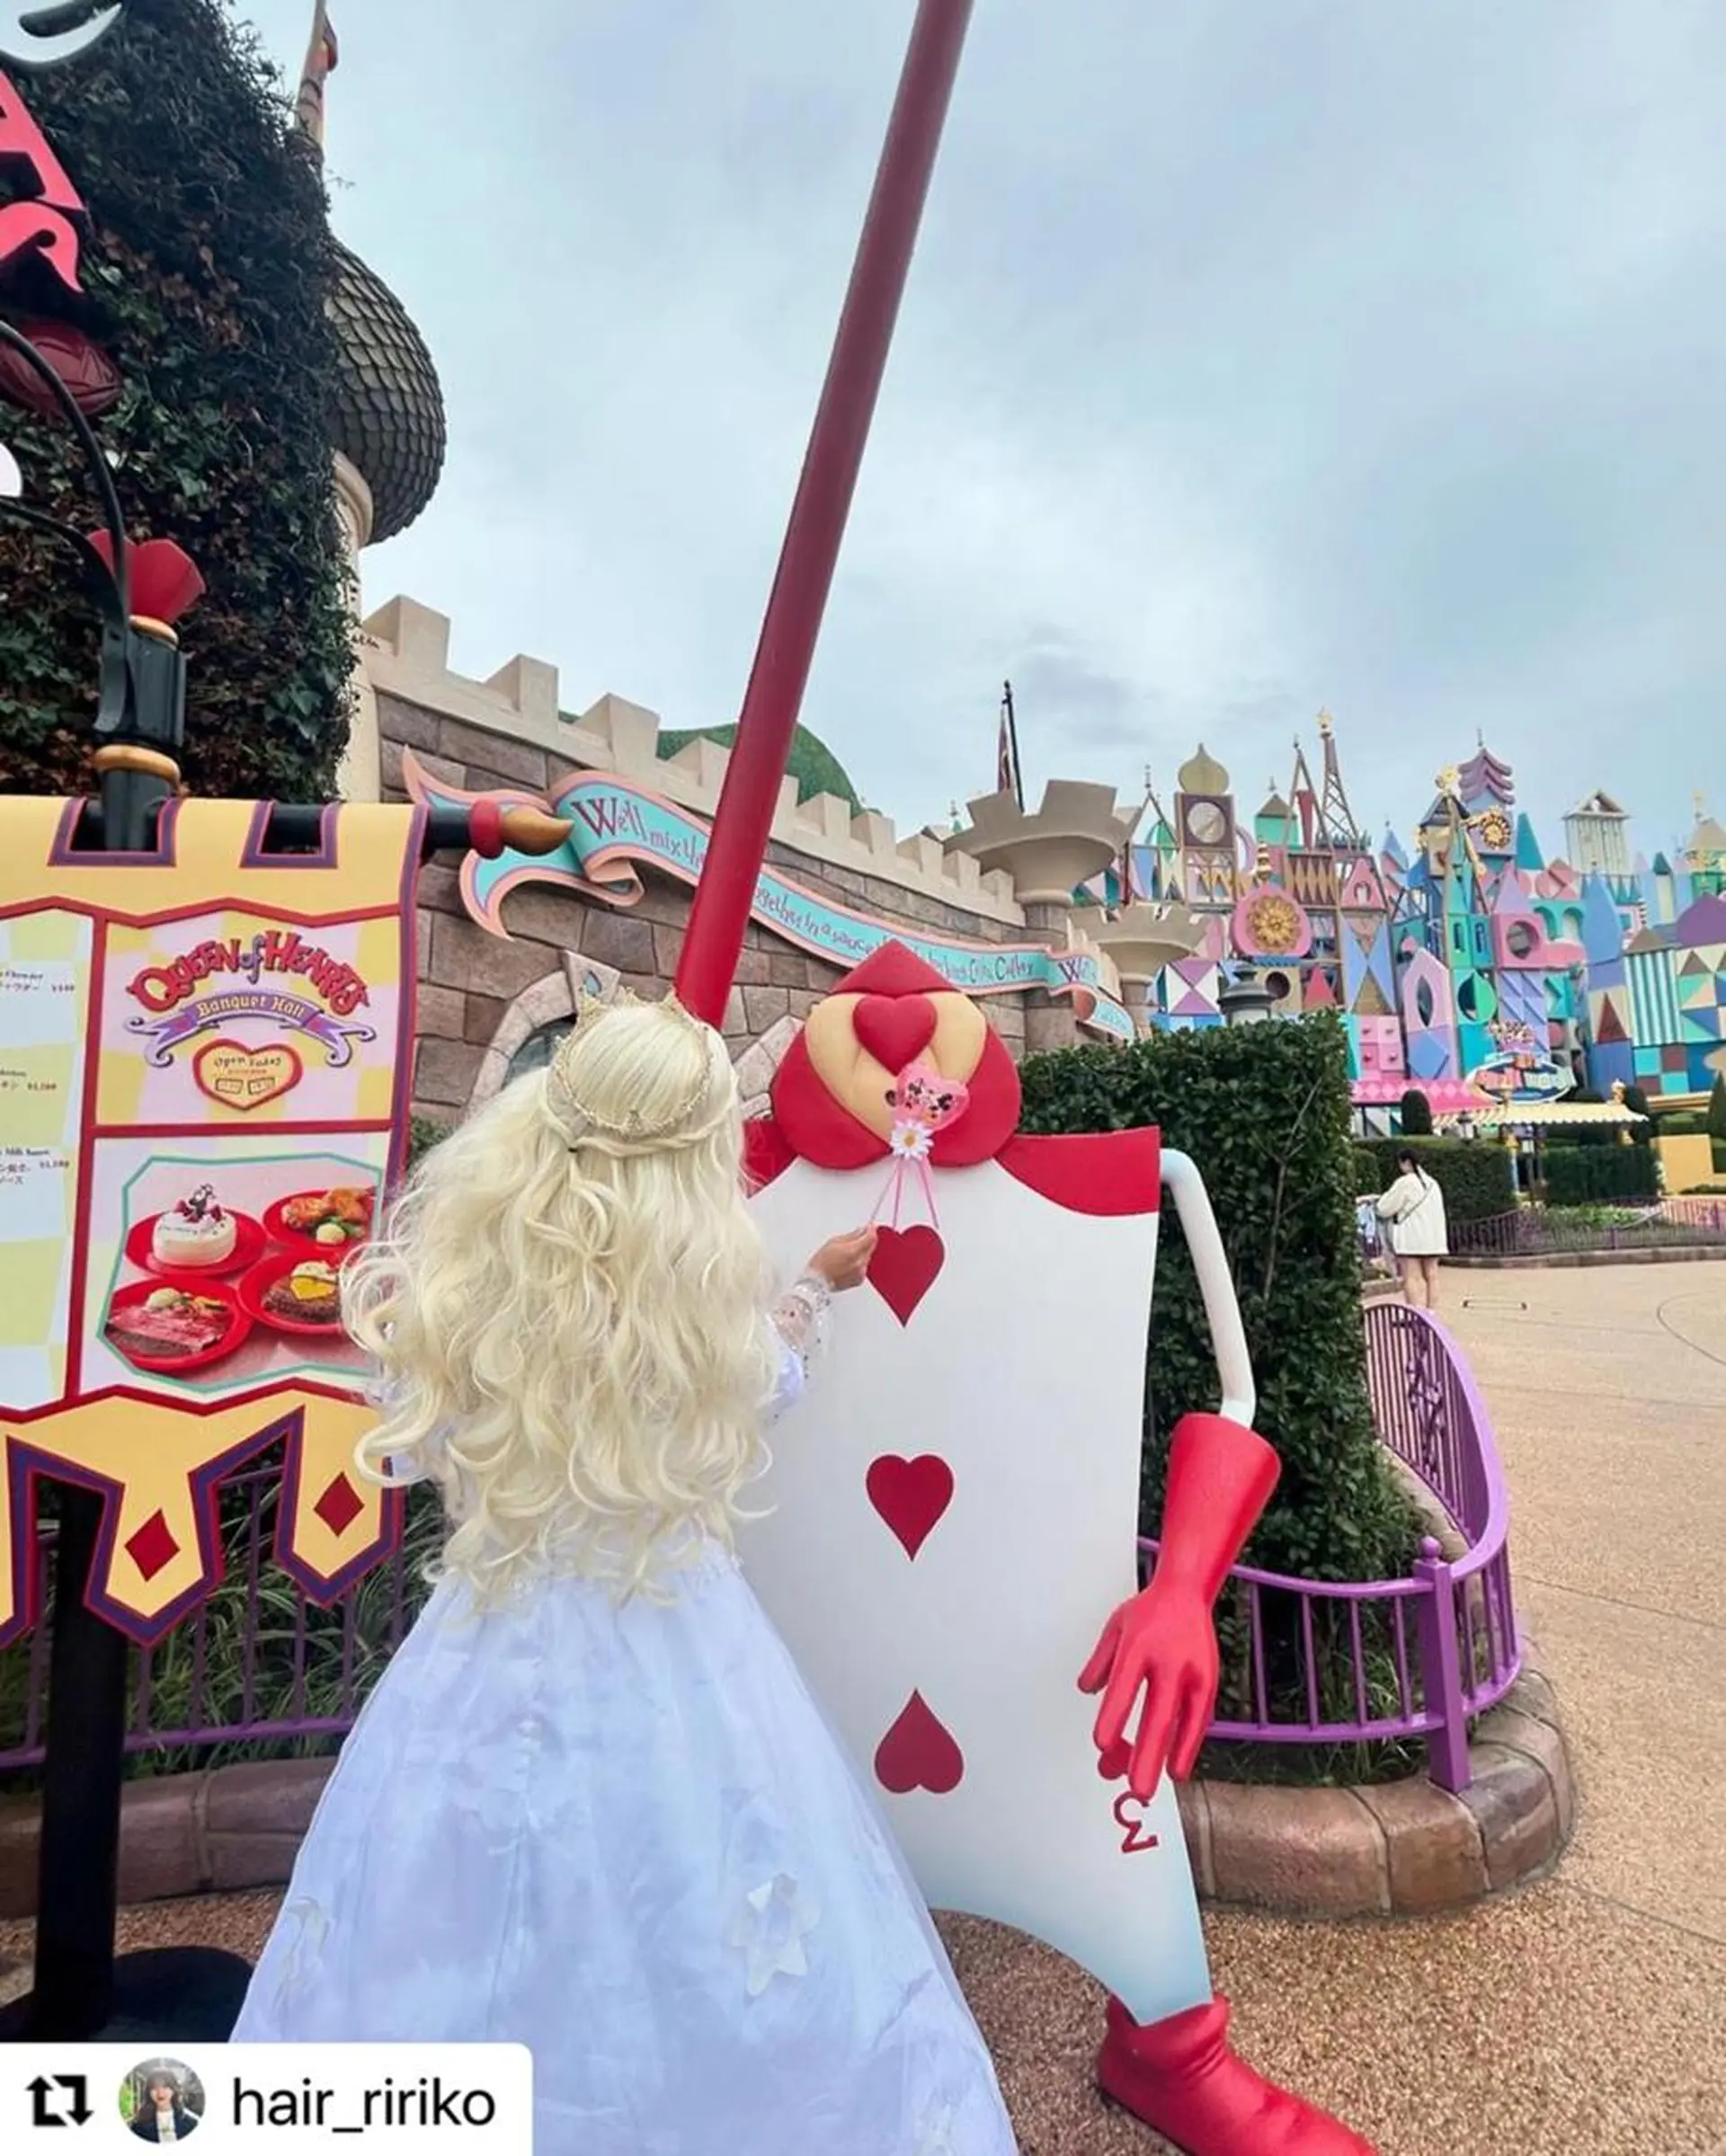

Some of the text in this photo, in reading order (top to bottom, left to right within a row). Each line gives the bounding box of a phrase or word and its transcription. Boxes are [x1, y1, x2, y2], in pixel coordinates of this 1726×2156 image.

[126, 929, 371, 1016] QUEEN of HEARTS
[197, 994, 307, 1018] Banquet Hall
